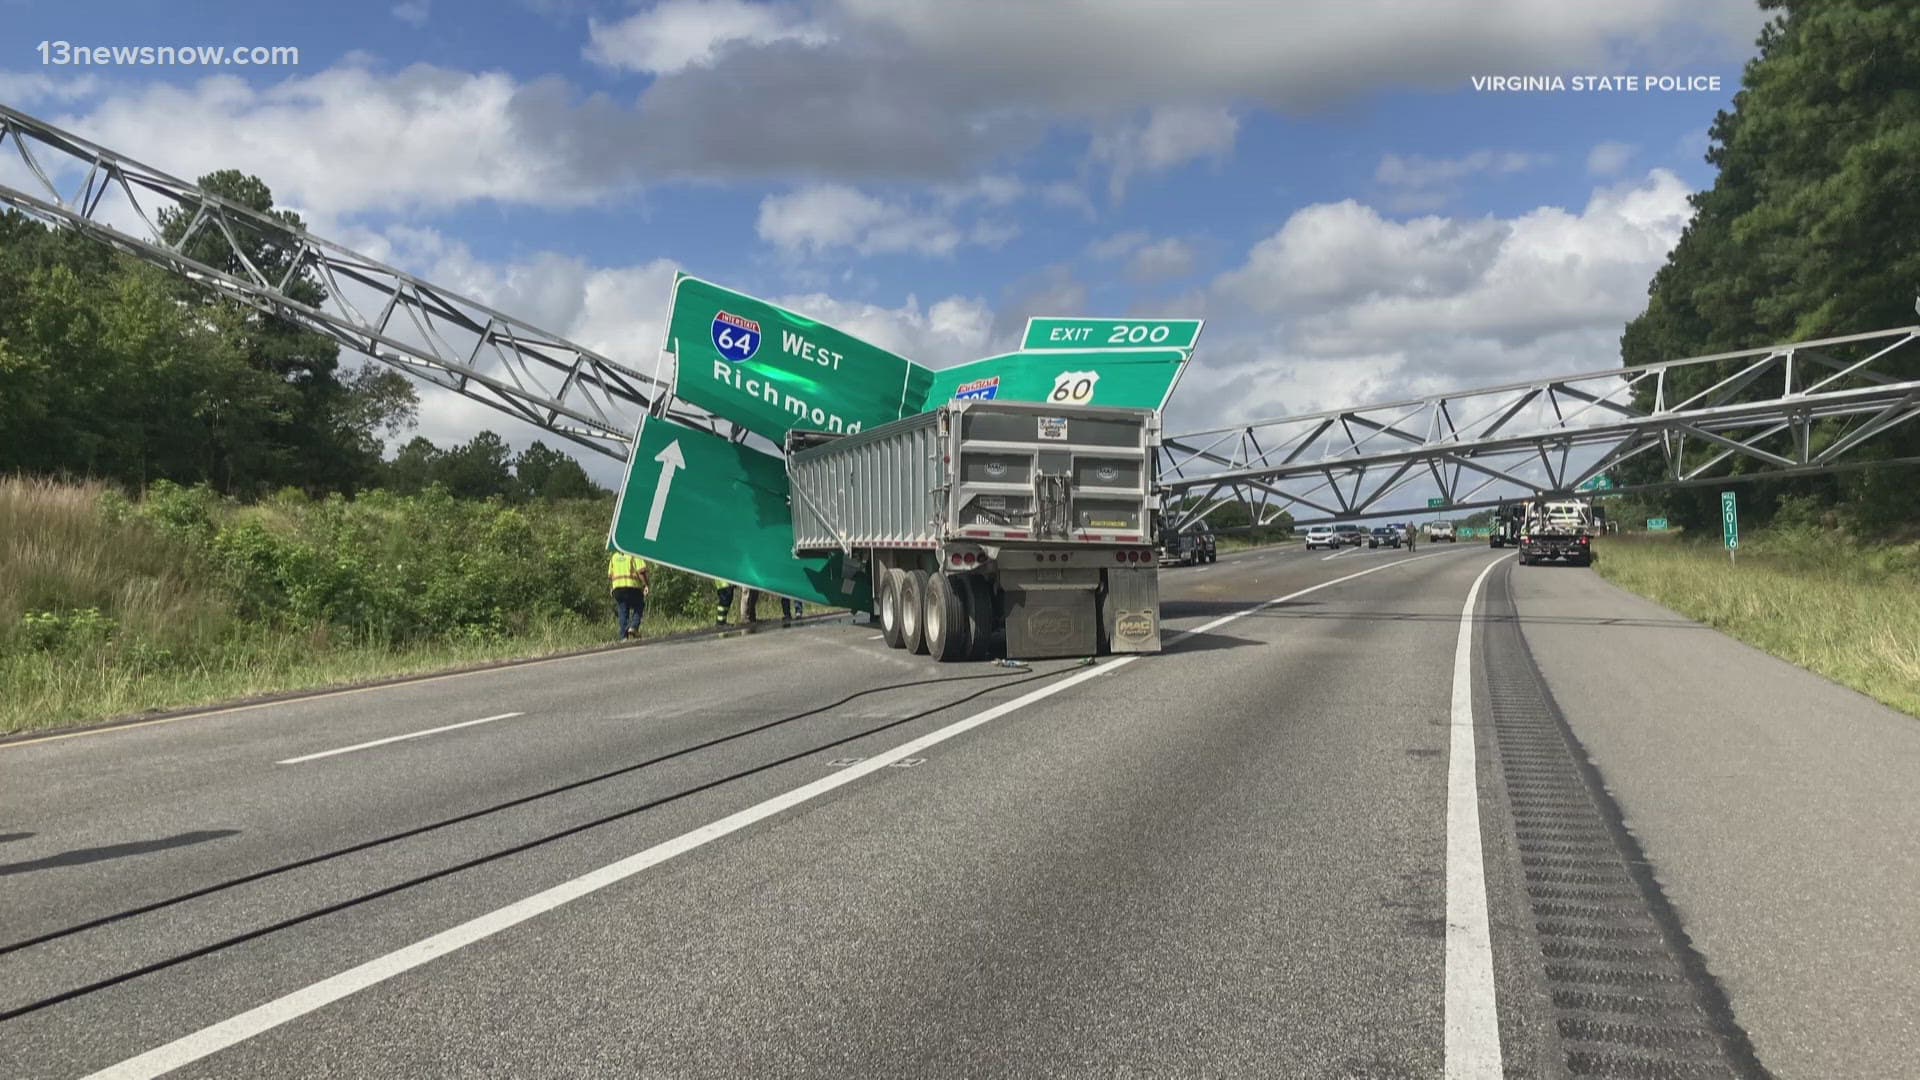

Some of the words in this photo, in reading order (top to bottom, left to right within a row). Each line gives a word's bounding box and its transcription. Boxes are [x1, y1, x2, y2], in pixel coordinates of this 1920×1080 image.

[718, 328, 751, 355] 64
[1050, 327, 1093, 341] EXIT
[1107, 325, 1170, 343] 200
[782, 330, 843, 370] WEST
[713, 359, 862, 434] Richmond
[1053, 378, 1091, 401] 60
